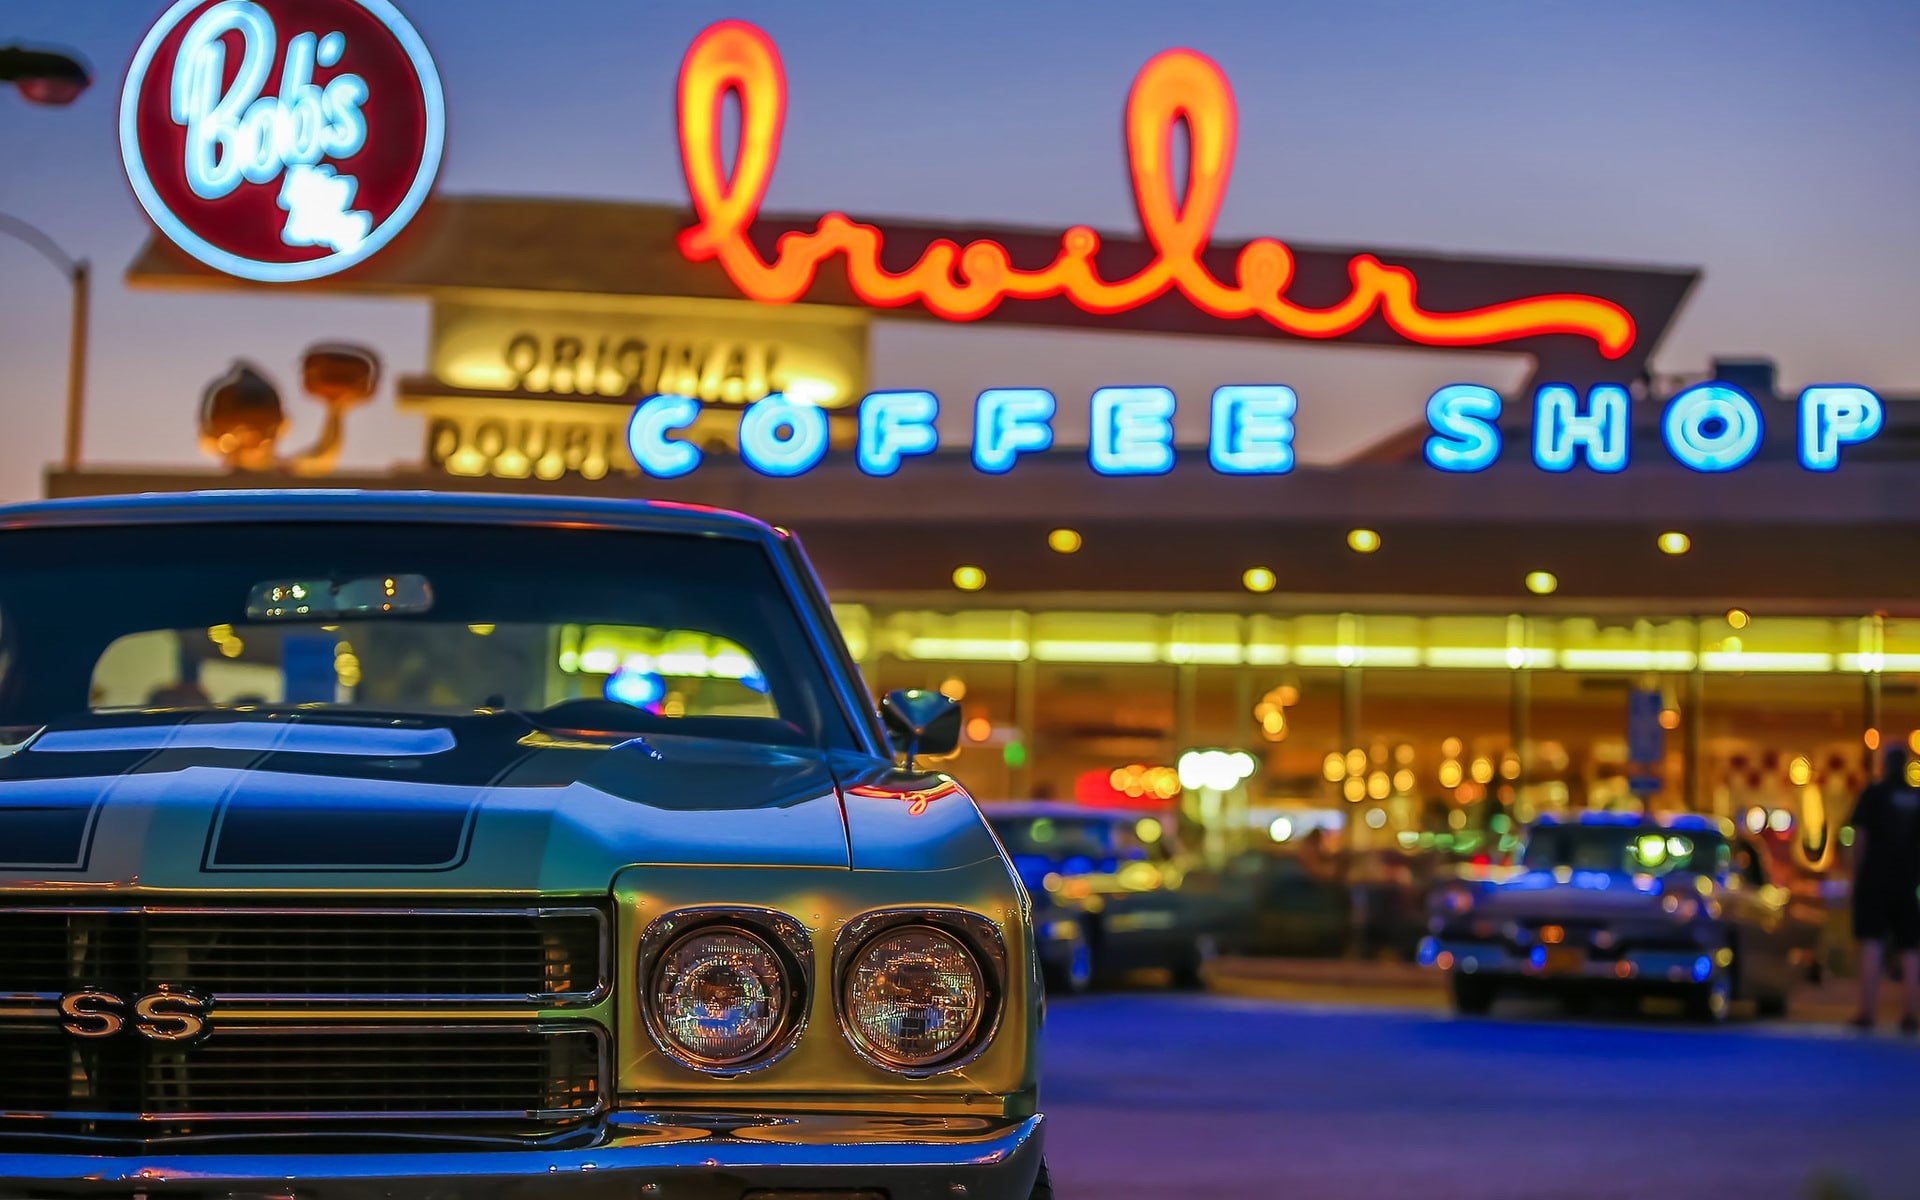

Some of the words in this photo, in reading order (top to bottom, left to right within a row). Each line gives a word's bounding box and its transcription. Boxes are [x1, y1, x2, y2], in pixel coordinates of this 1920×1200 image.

[170, 0, 369, 200] Bob's
[677, 19, 1638, 360] broiler
[627, 384, 1297, 478] COFFEE
[1423, 380, 1886, 473] SHOP
[59, 989, 205, 1042] SS
